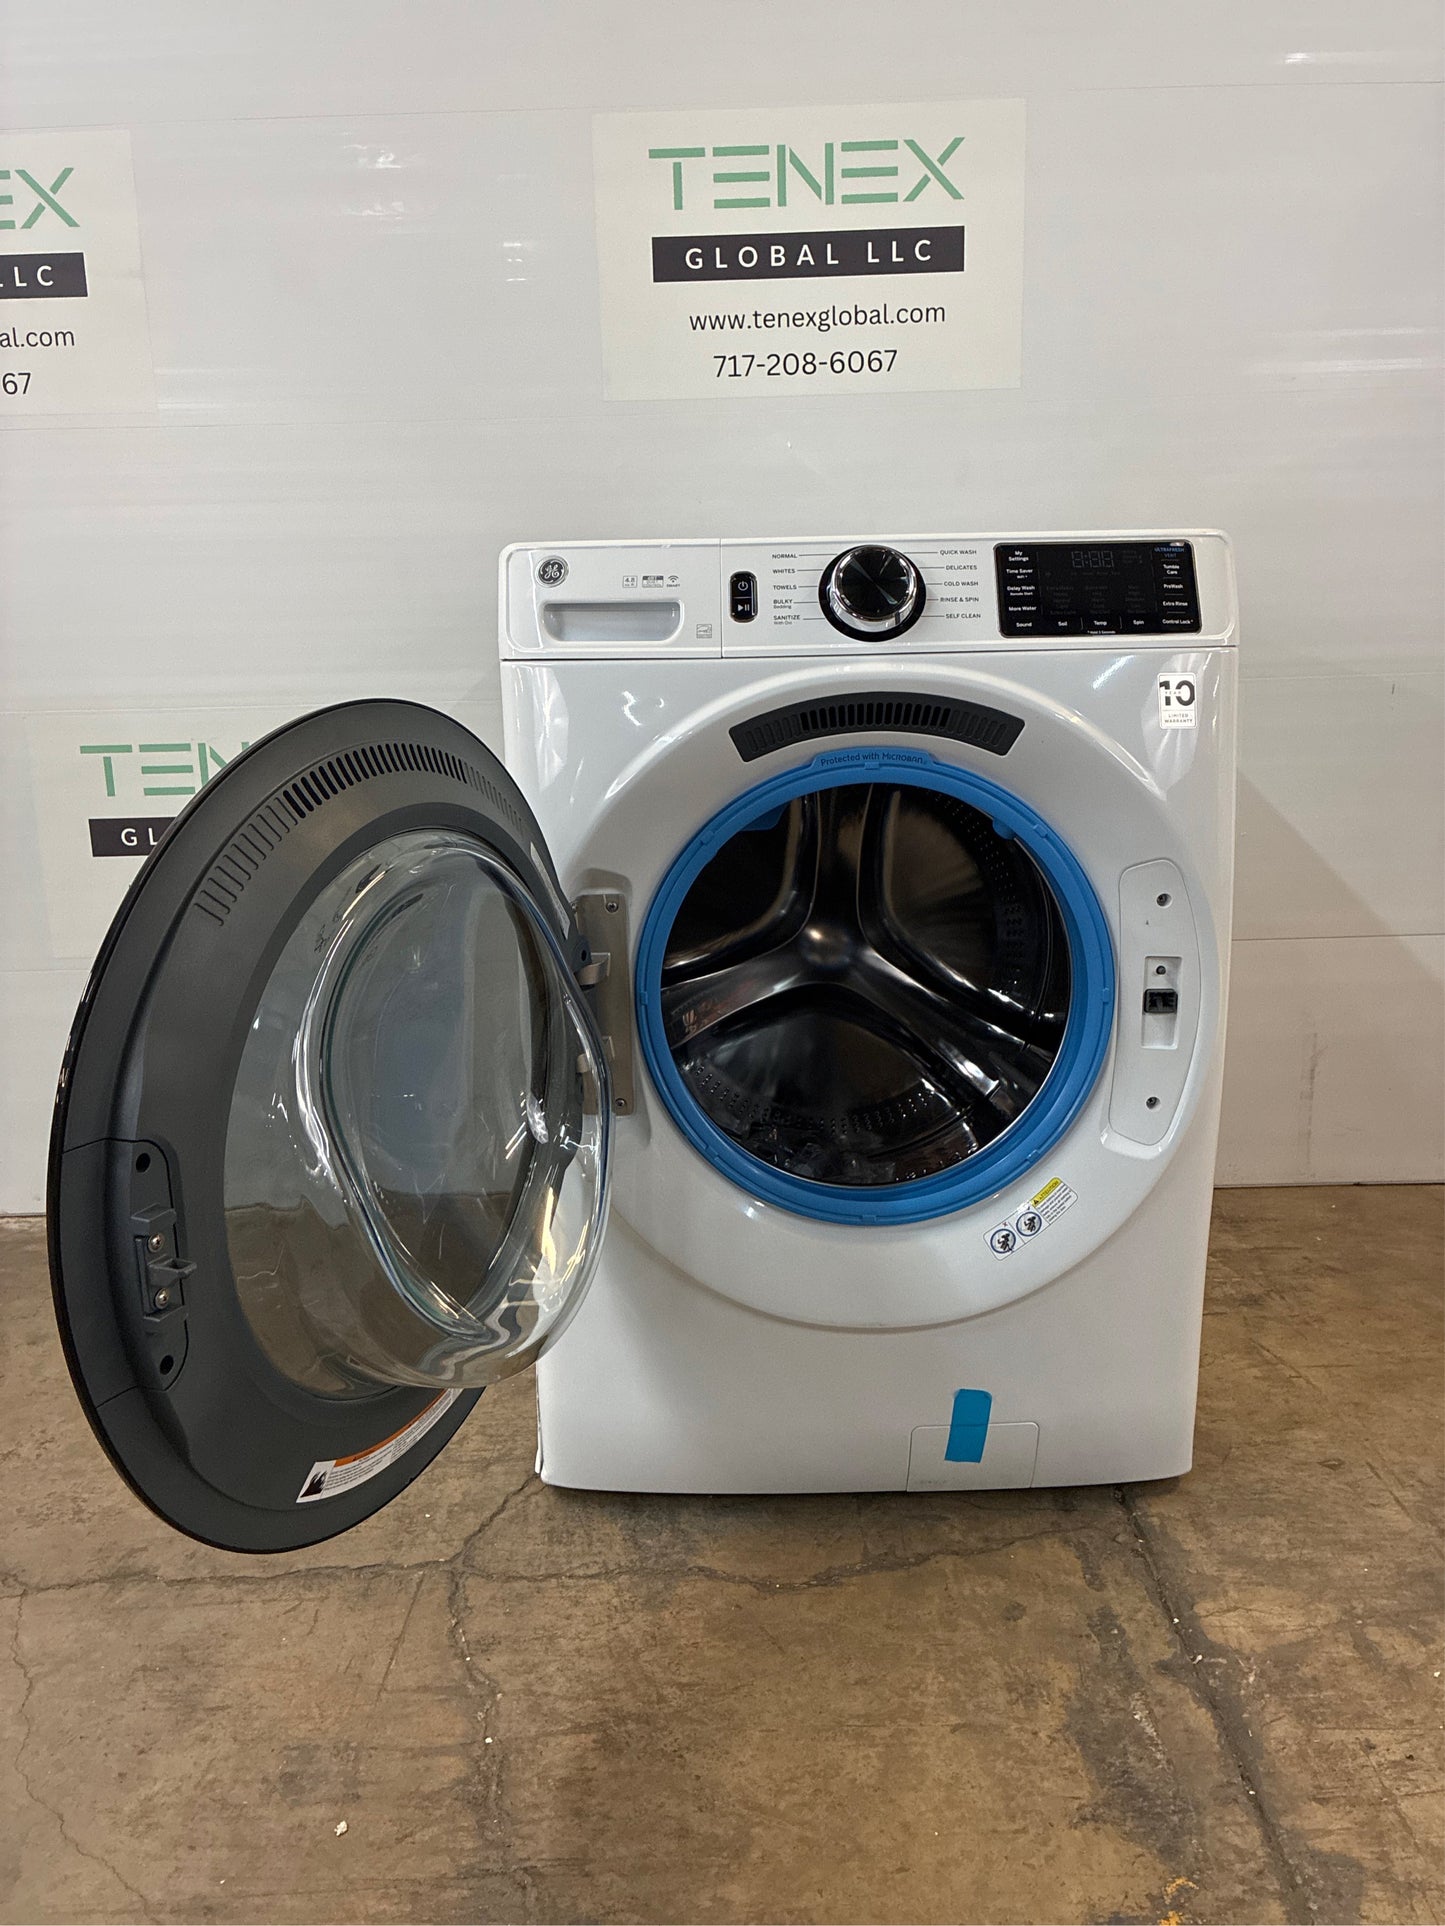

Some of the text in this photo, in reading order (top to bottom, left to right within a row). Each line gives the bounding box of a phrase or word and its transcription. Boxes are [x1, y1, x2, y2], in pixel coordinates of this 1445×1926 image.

[648, 136, 966, 210] TENEX
[0, 167, 80, 229] X
[684, 239, 932, 269] GLOBAL LLC
[0, 265, 54, 287] LC
[689, 303, 946, 332] www.tenexglobal.com
[713, 349, 898, 378] 717-208-6067
[2, 372, 32, 394] 67
[1159, 680, 1195, 706] 10
[820, 752, 861, 766] Protected
[862, 752, 880, 760] with
